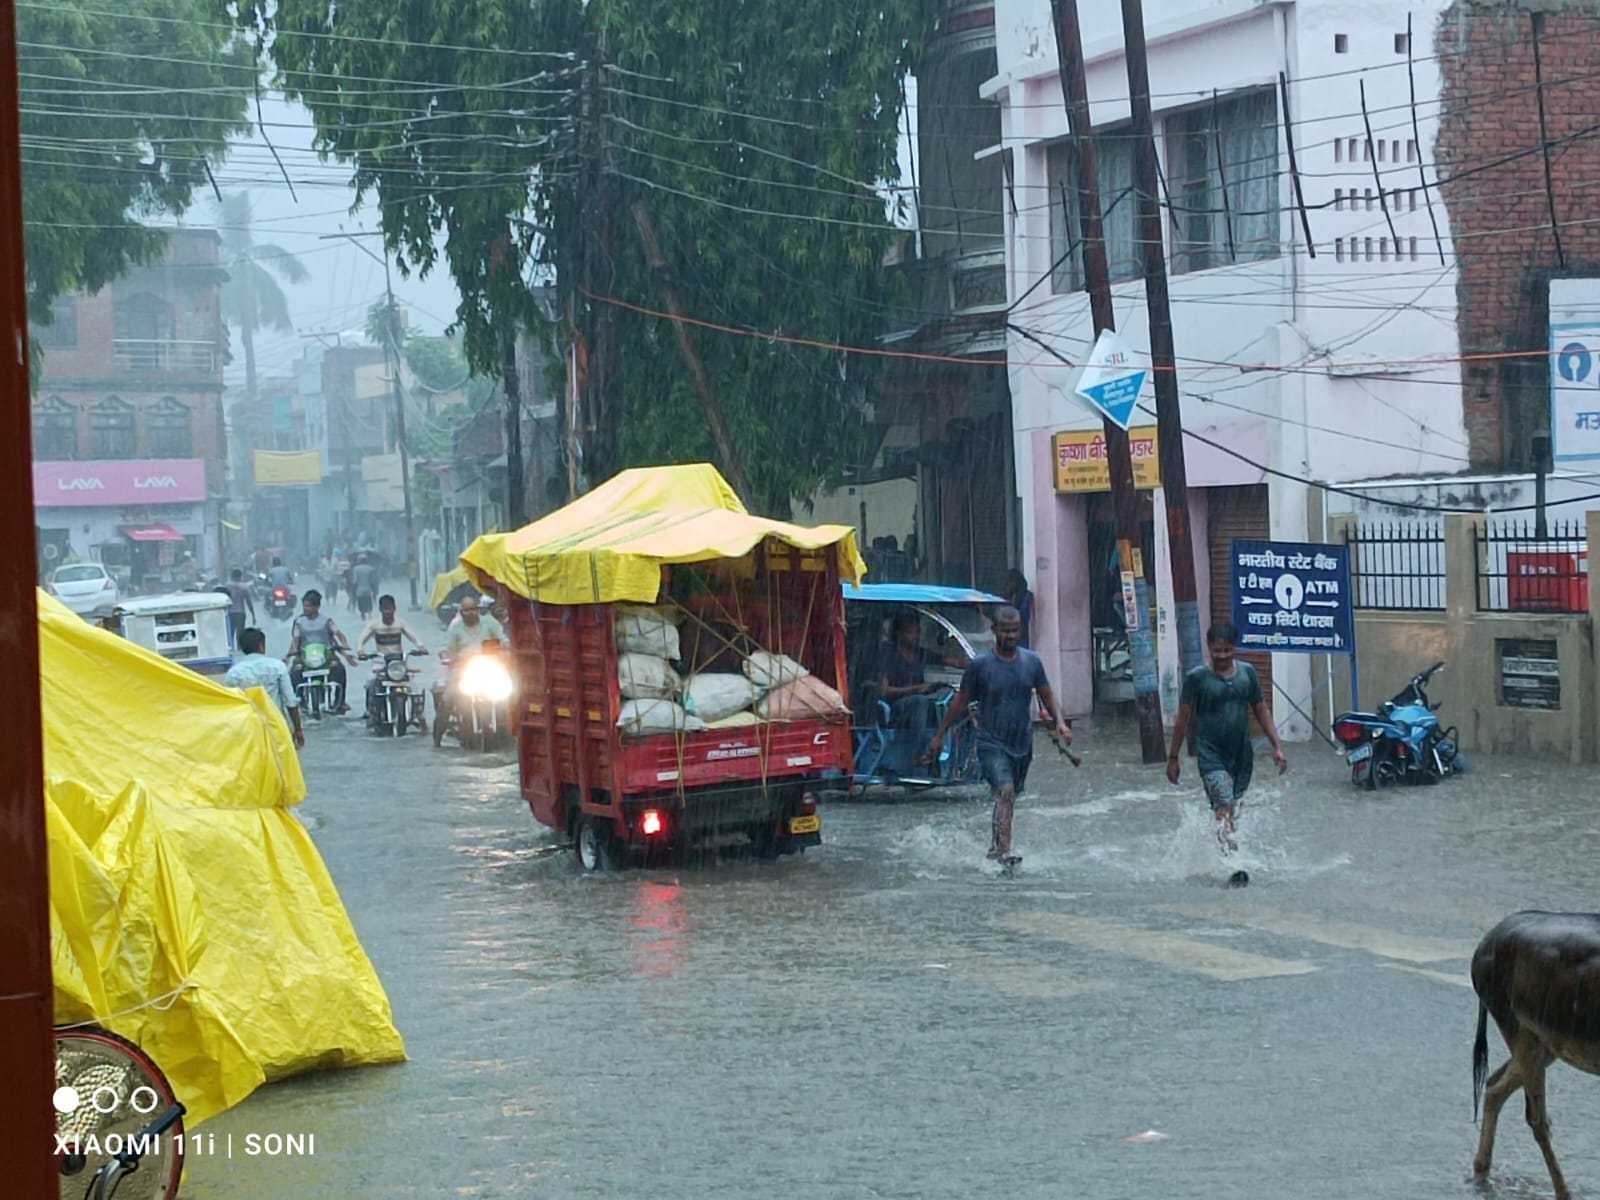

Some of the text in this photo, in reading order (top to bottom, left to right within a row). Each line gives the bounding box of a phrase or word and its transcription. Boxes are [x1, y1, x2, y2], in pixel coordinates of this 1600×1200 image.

[58, 478, 105, 490] LAVA
[133, 475, 178, 488] LAVA
[1238, 550, 1338, 570] भारतीय स्टेट बैंक
[1305, 581, 1339, 594] ATM
[1275, 611, 1300, 627] सिटी
[1303, 613, 1334, 628] शाखा
[813, 732, 830, 745] C
